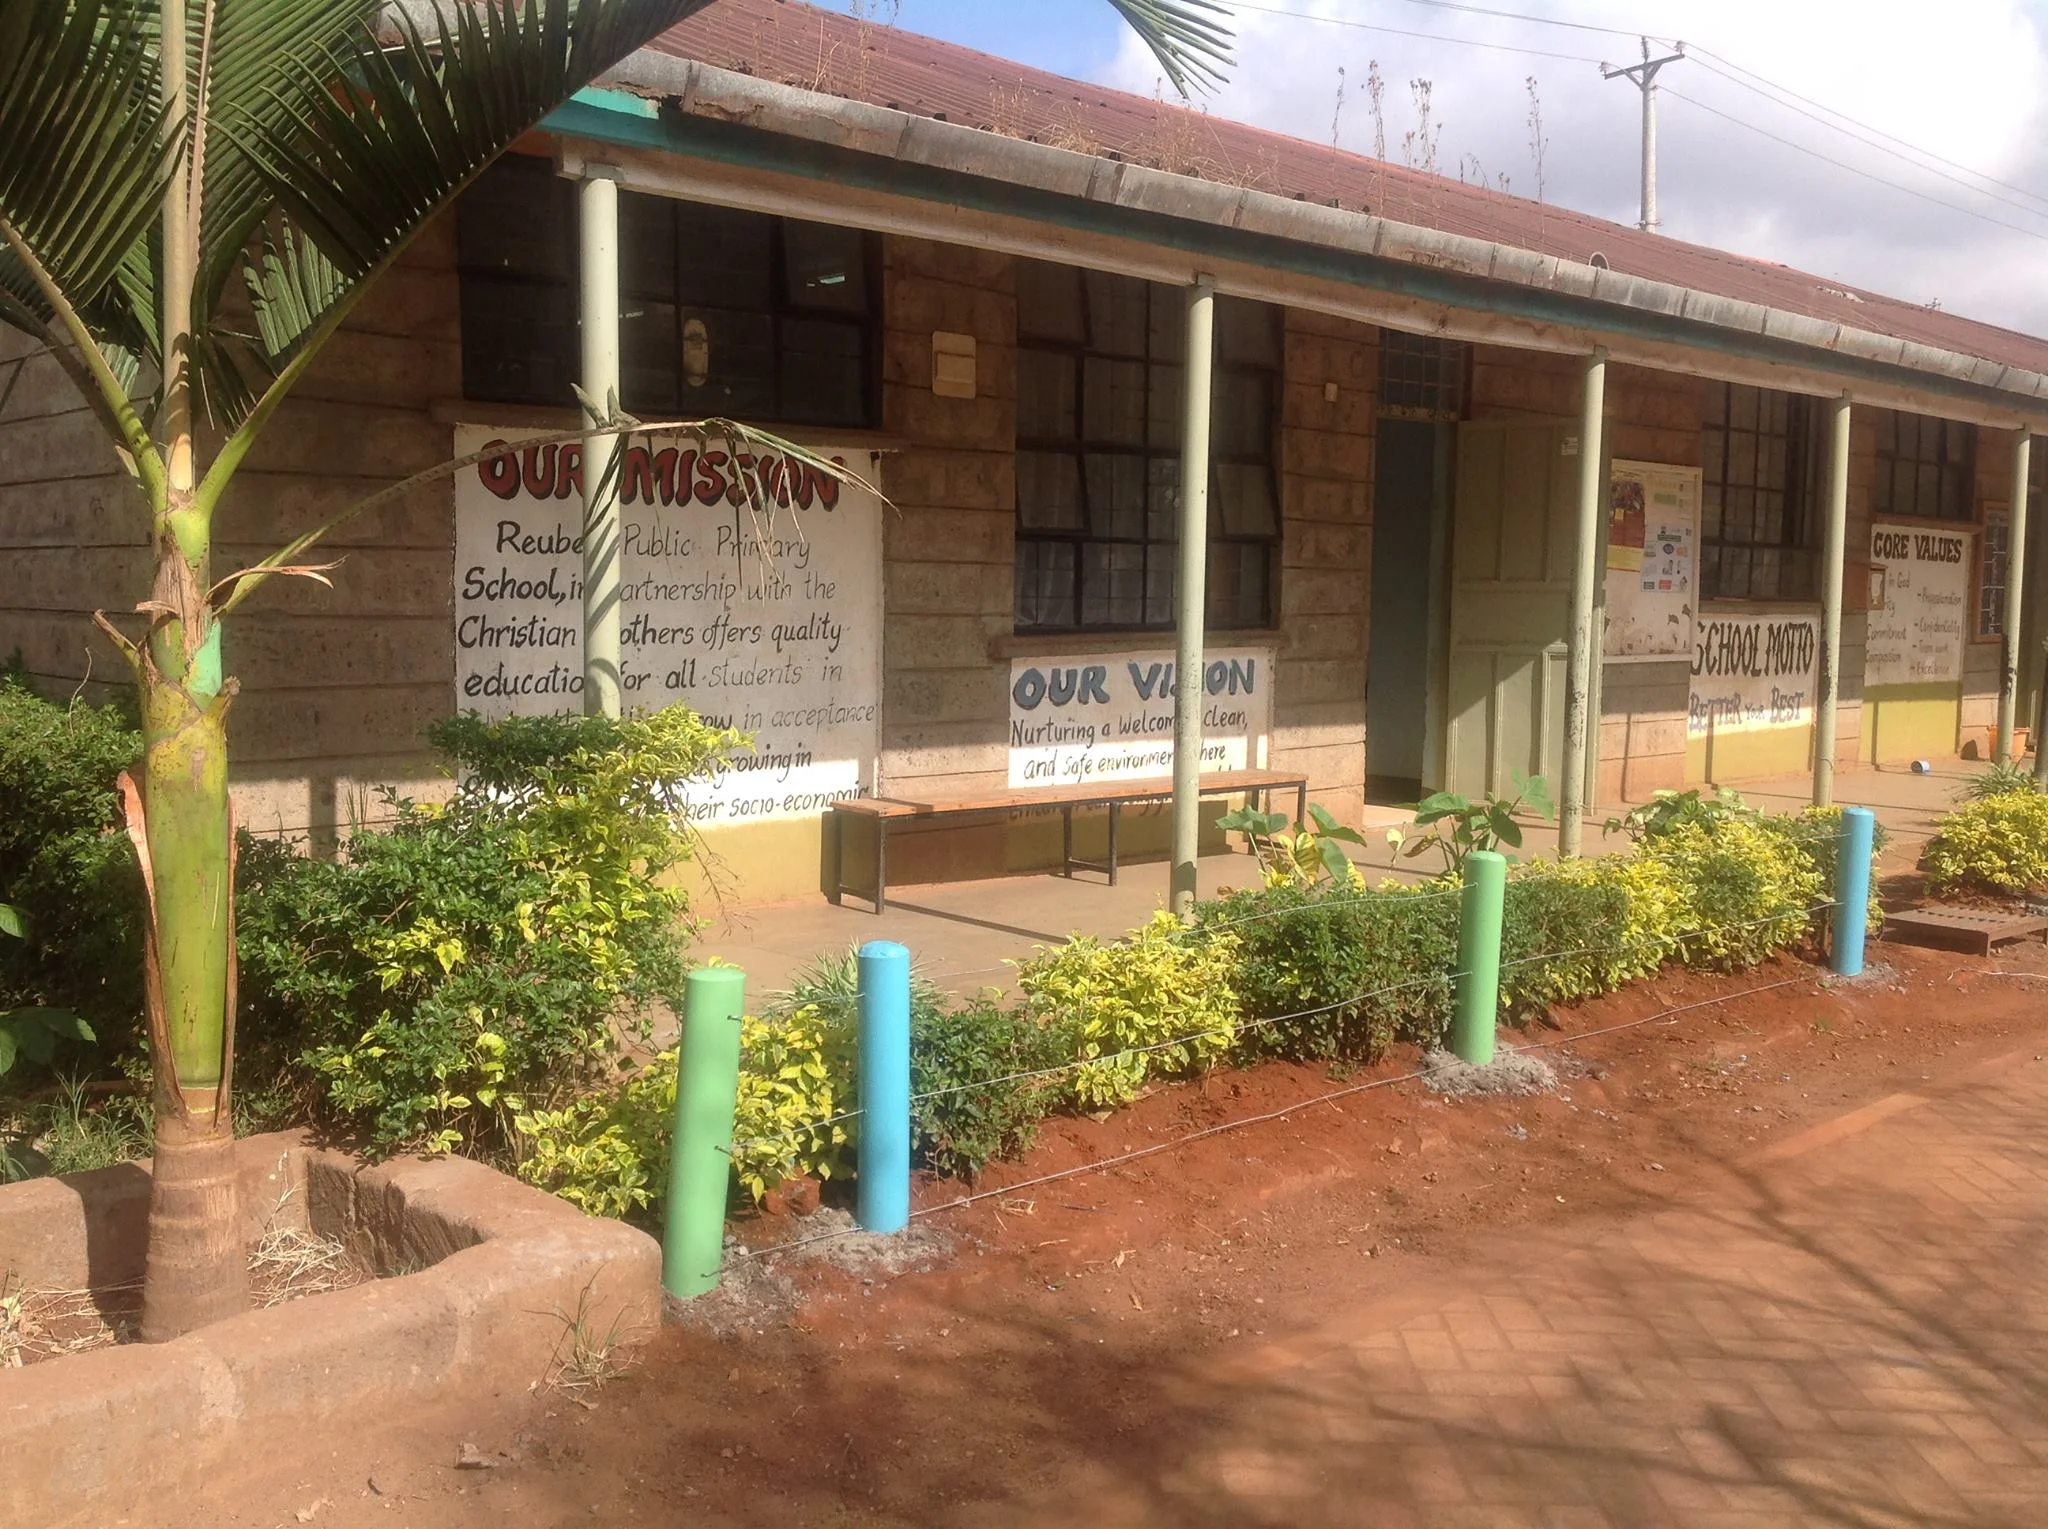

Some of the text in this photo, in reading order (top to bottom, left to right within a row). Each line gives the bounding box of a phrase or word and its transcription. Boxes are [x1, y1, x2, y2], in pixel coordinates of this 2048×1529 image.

[478, 439, 845, 512] OUR MISSION
[496, 520, 811, 569] Reube Public Primary
[1873, 531, 1963, 564] CORE VALUES
[462, 566, 566, 607] School,
[620, 571, 737, 604] artnership
[747, 574, 793, 602] with
[805, 571, 837, 600] the
[458, 612, 843, 653] Christian others offers quality
[1690, 621, 1815, 677] SCHOOL MOTTO
[463, 660, 585, 698] educatio
[665, 659, 697, 690] all
[822, 656, 843, 683] in
[1013, 658, 1254, 711] OUR VION
[743, 705, 763, 730] in
[771, 698, 876, 734] acceptance
[1769, 684, 1805, 723] BEST
[1011, 715, 1096, 749] Nurturing
[1101, 722, 1111, 738] a
[1119, 709, 1175, 736] Welcom
[716, 744, 792, 791] growing
[795, 743, 813, 769] in
[1024, 748, 1058, 780] and
[1098, 748, 1175, 772] environmen
[1200, 742, 1226, 762] here
[682, 792, 725, 822] heir
